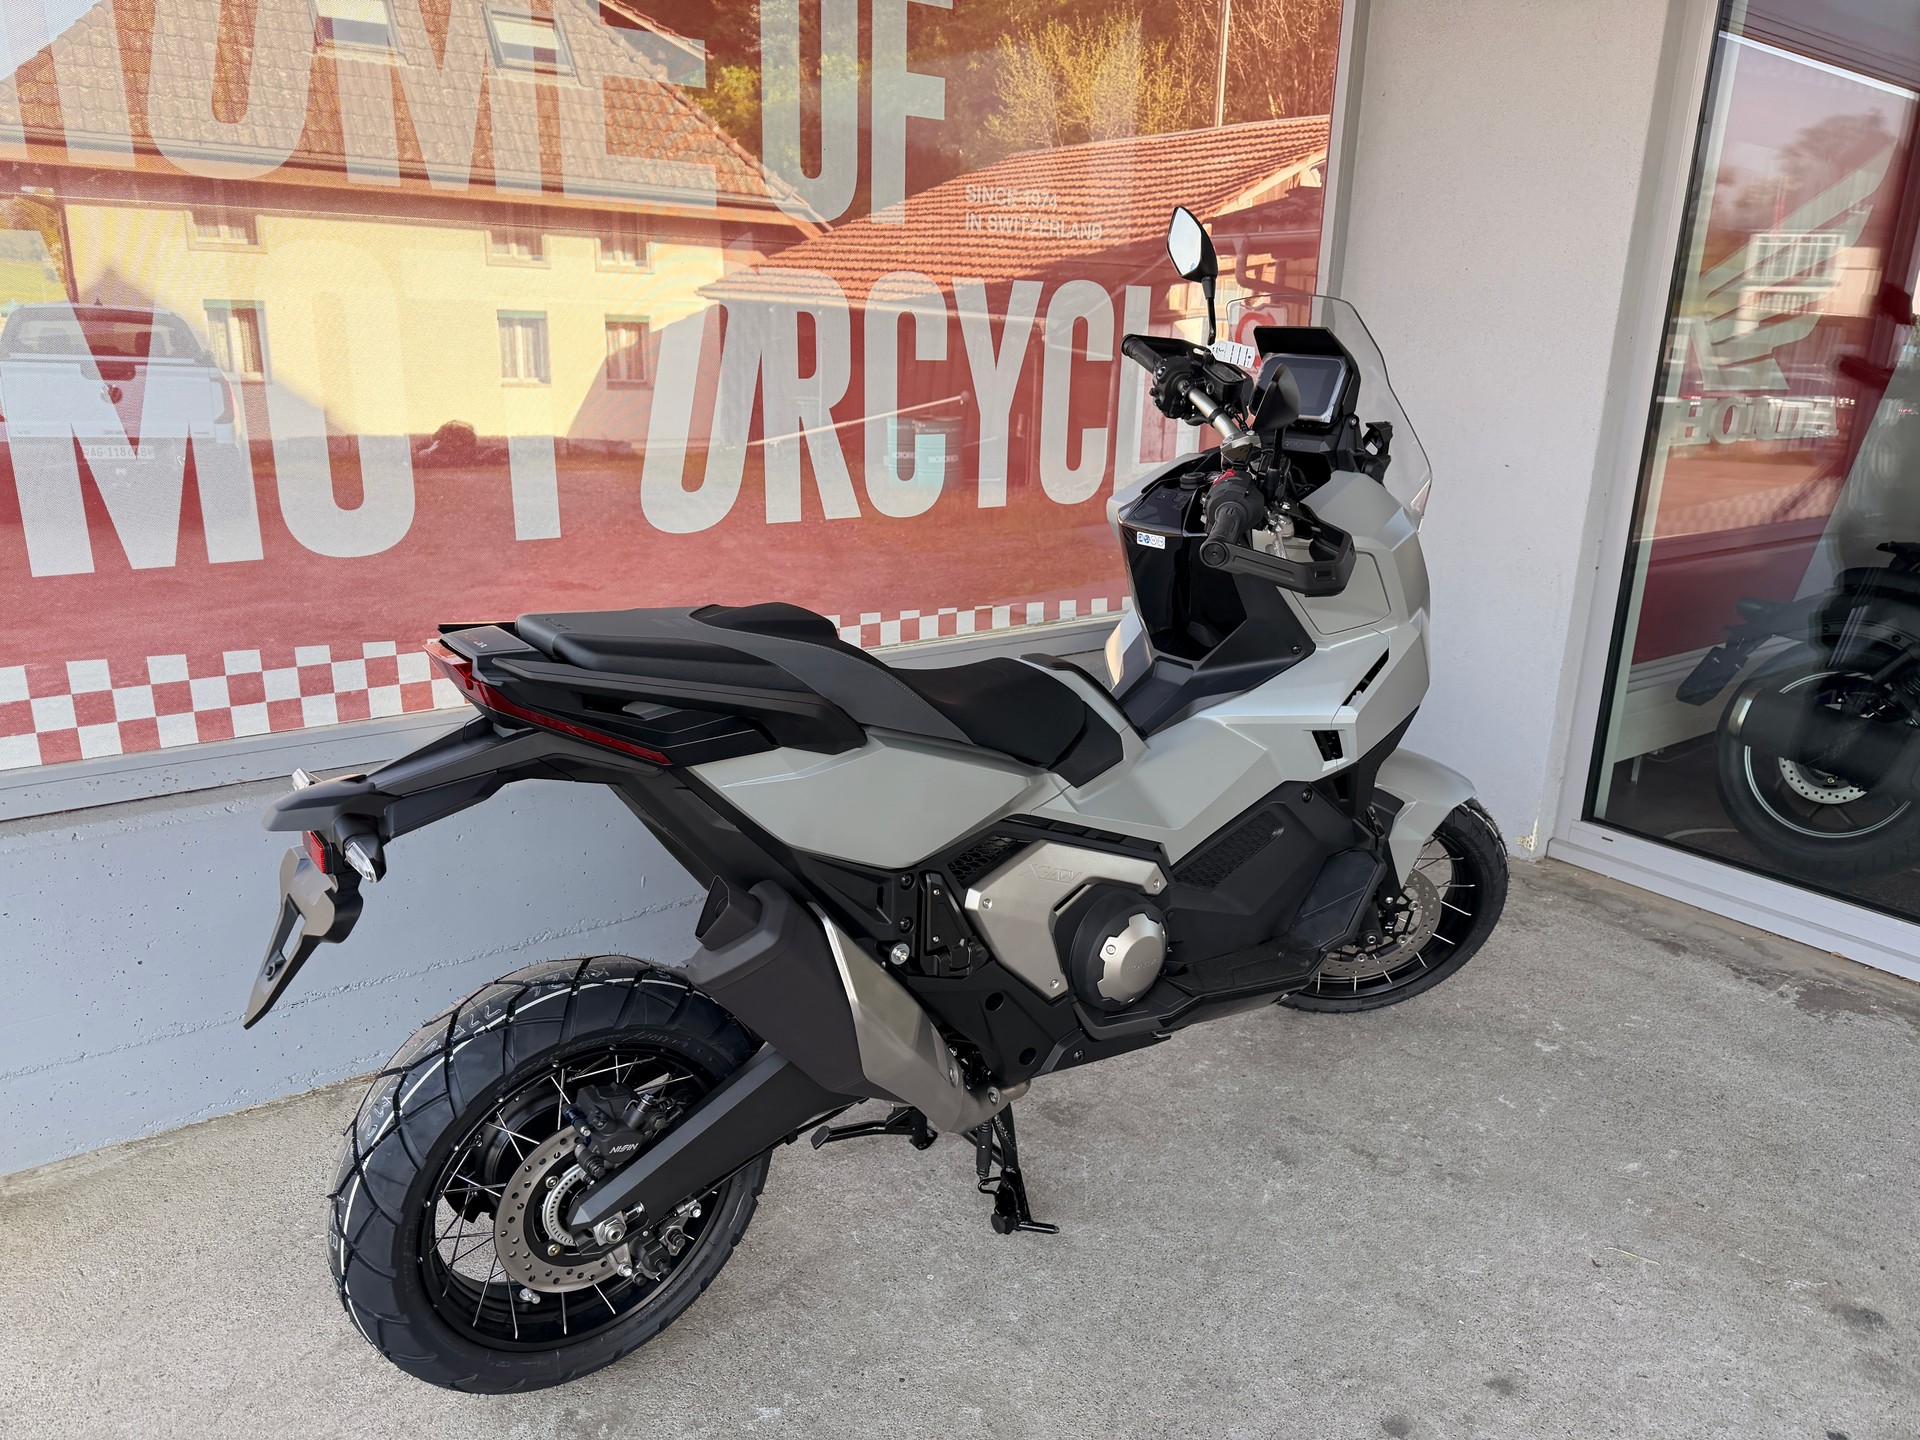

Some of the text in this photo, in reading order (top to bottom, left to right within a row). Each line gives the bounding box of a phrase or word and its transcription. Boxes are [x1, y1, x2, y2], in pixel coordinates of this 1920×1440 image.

[760, 0, 954, 226] OF
[965, 184, 1058, 211] SINCE 1974
[965, 212, 1103, 240] IN SWITZERLAND
[1668, 396, 1840, 446] HONDA
[608, 1142, 639, 1154] NISSIN
